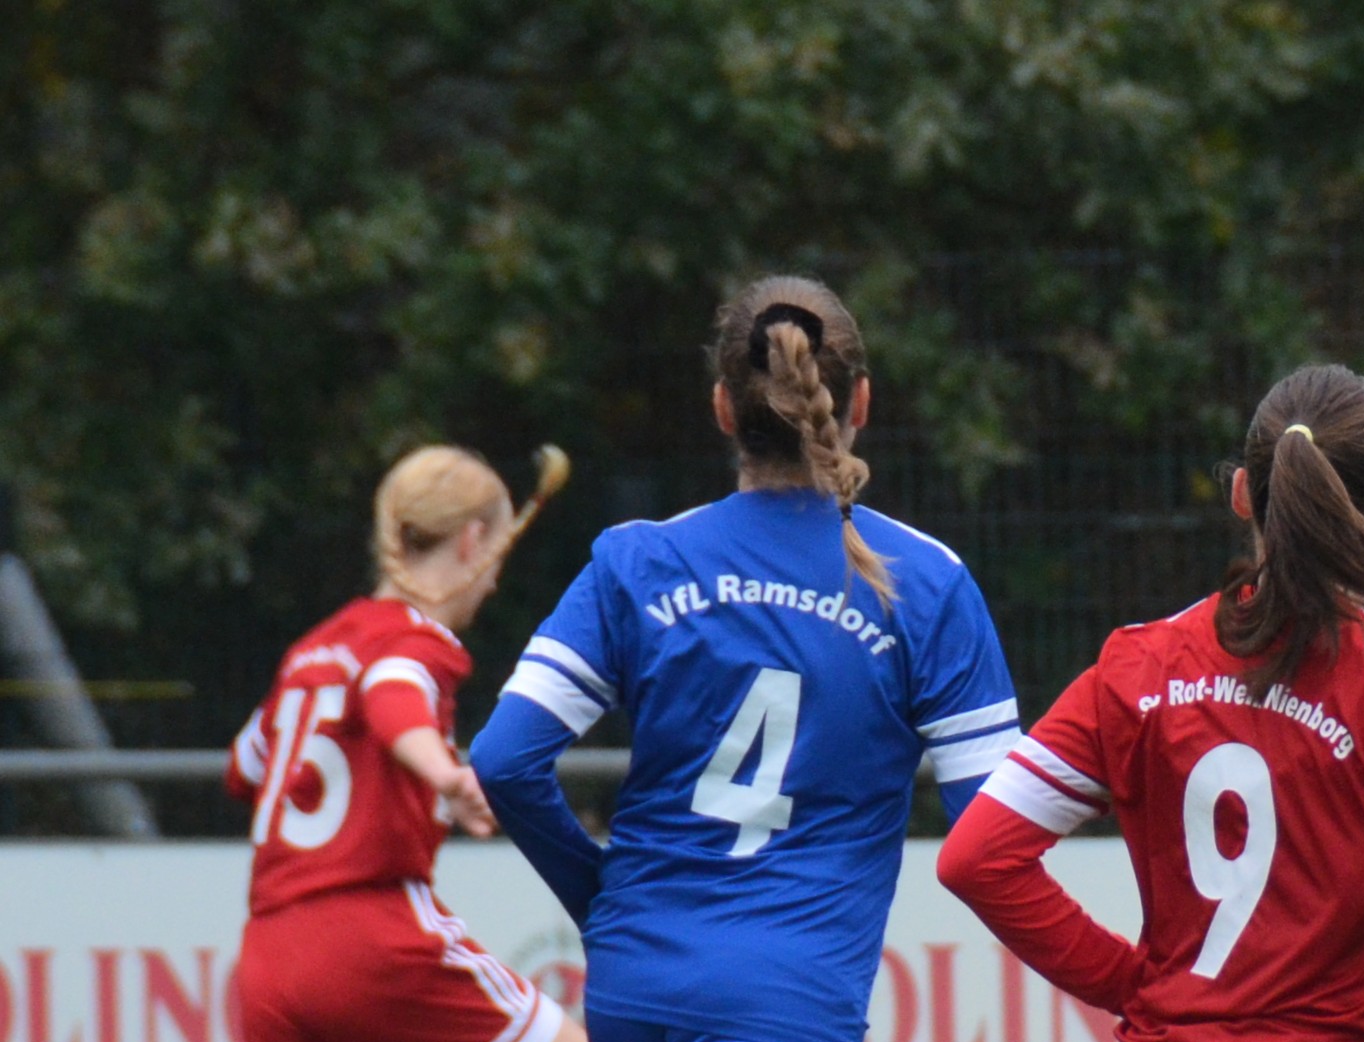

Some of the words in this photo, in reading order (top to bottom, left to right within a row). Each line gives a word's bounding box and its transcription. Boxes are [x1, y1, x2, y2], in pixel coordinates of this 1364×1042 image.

[646, 582, 711, 627] VfL
[717, 574, 897, 656] Ramsdorf
[252, 684, 352, 850] 15
[690, 667, 802, 858] 4
[1168, 675, 1262, 709] Rot-We
[1264, 683, 1355, 761] Nienborg
[1183, 741, 1278, 980] 9
